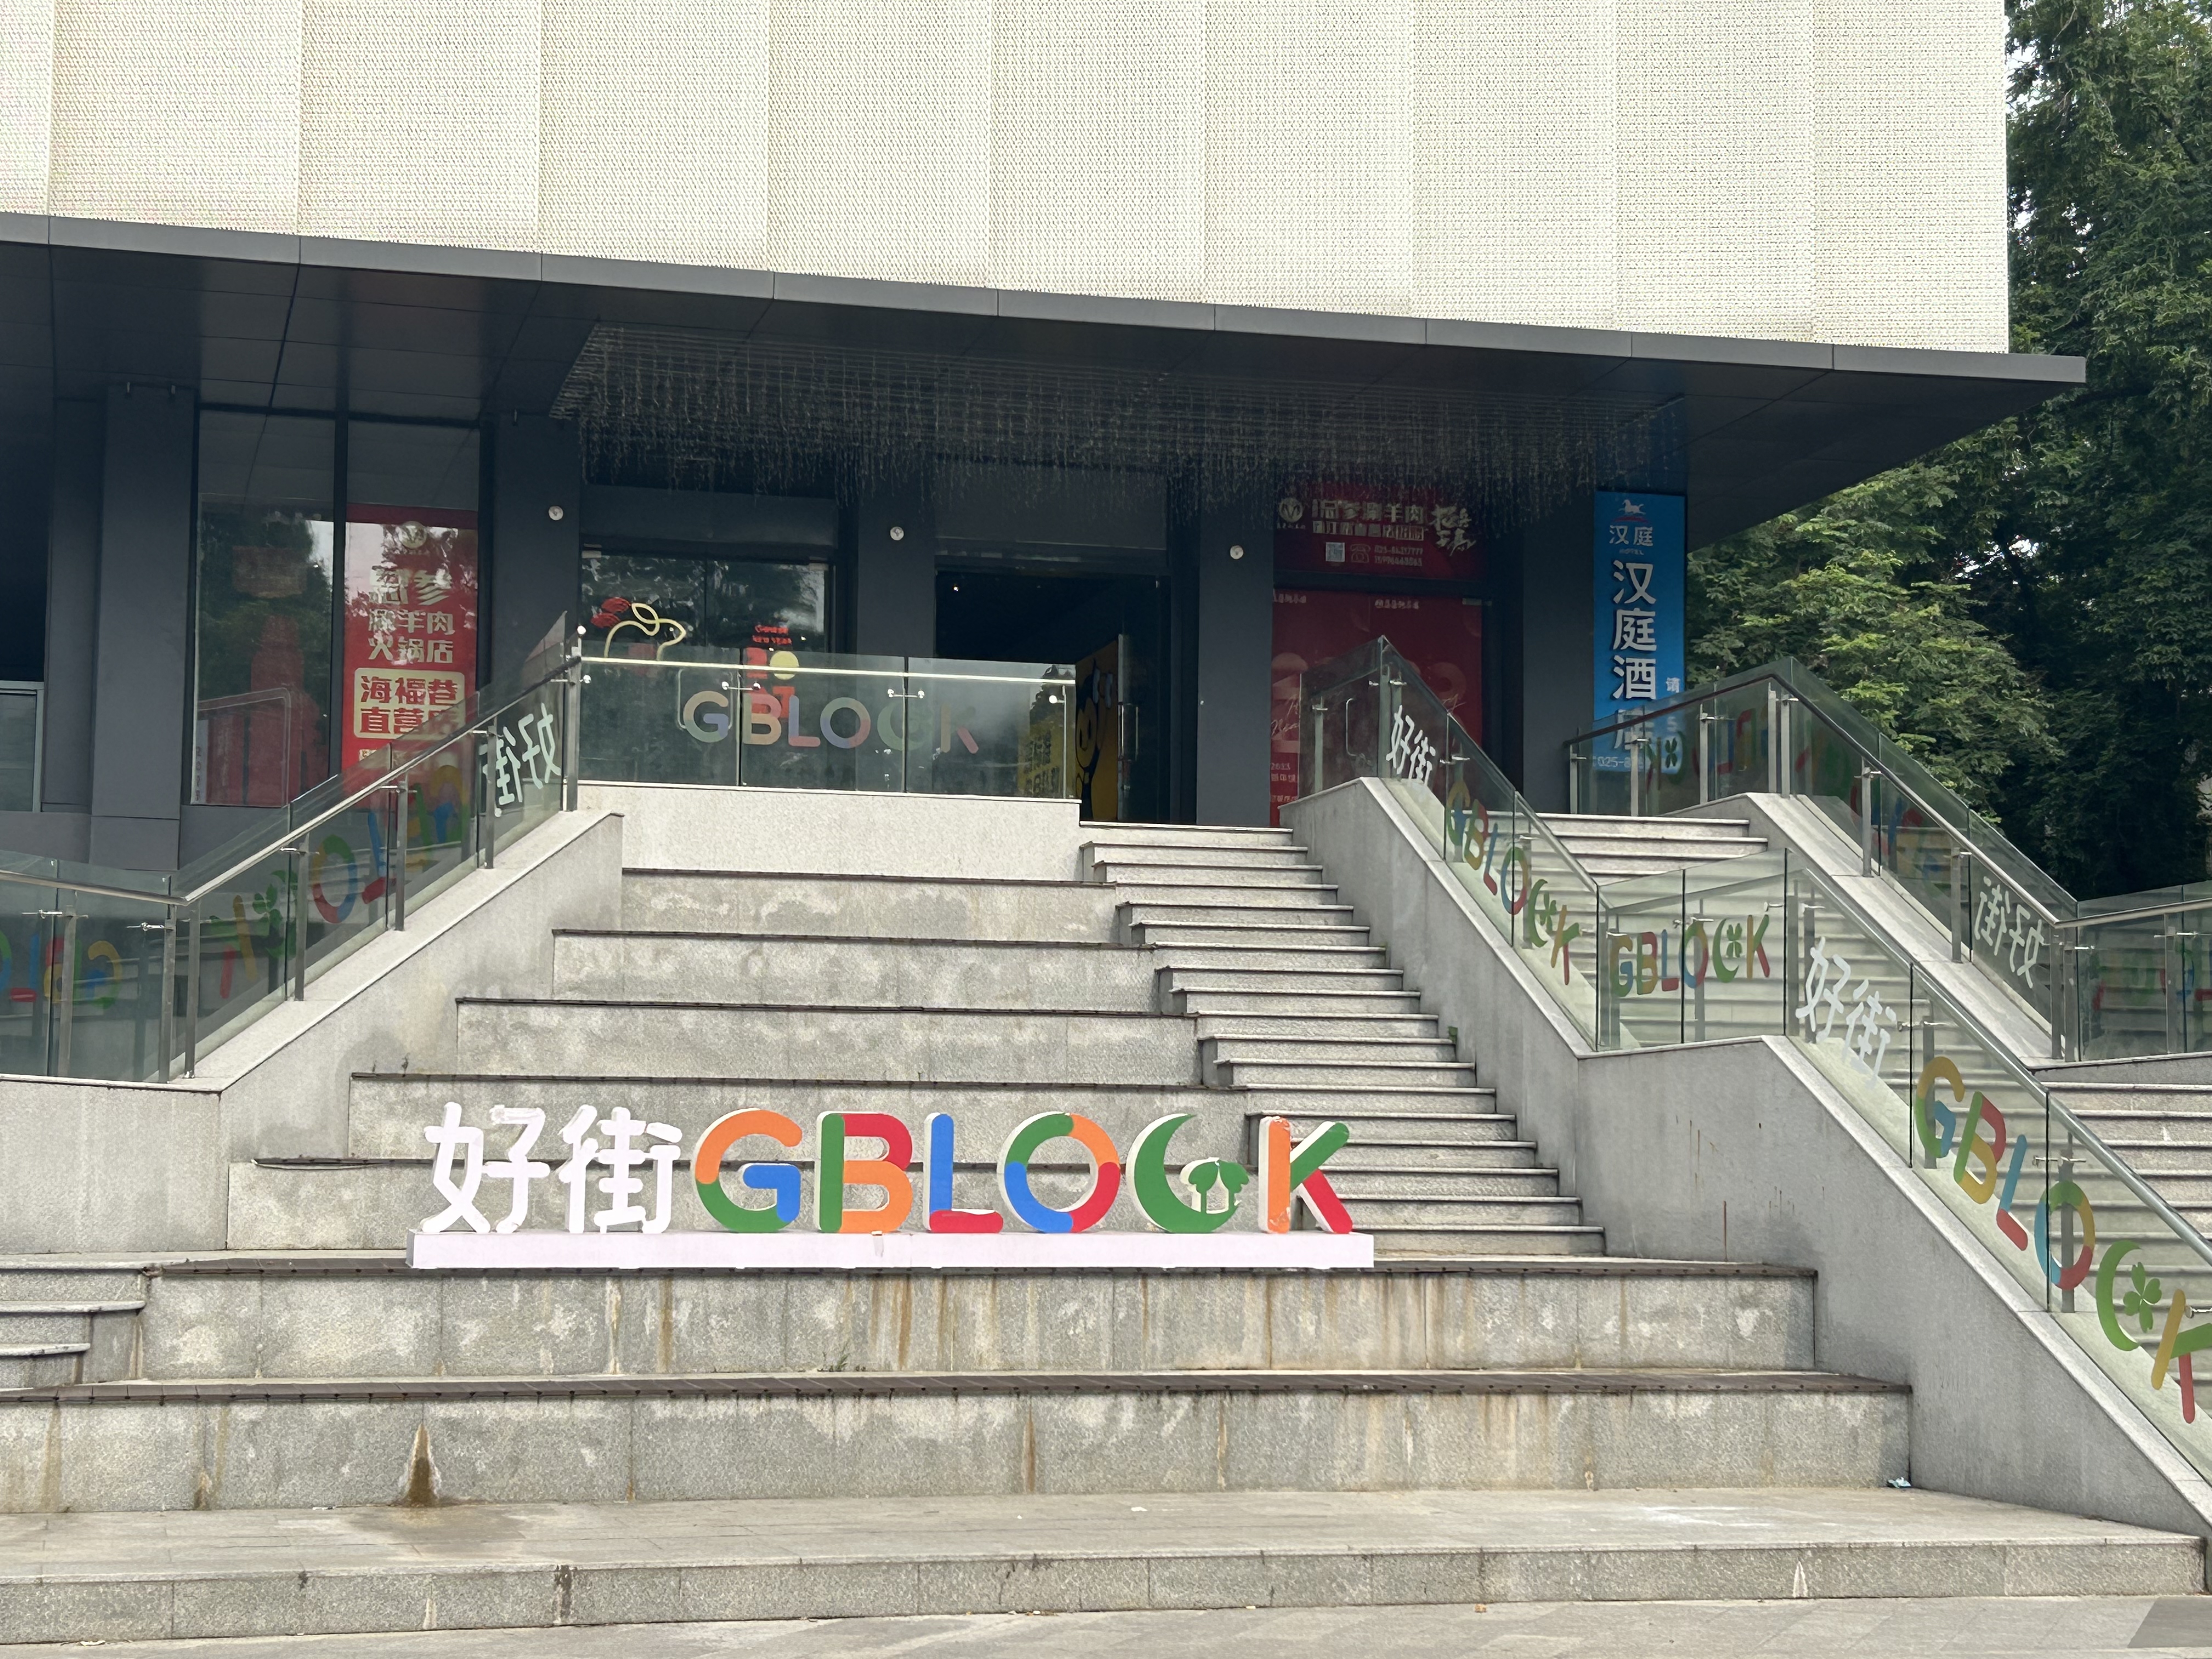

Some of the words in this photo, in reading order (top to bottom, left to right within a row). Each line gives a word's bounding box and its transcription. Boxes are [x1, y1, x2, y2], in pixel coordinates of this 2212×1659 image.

[1609, 525, 1654, 546] 汉庭
[360, 676, 458, 706] 海福巷
[682, 690, 979, 755] GBLOCK
[1386, 704, 1436, 785] 好街
[1445, 781, 1580, 985] GBLOCK
[1610, 914, 1770, 997] GBLOCK
[1795, 936, 1897, 1088] 好街
[420, 1101, 683, 1234] 好街
[693, 1107, 1354, 1235] GBLOCK
[1915, 1056, 2212, 1424] GBLOCK
